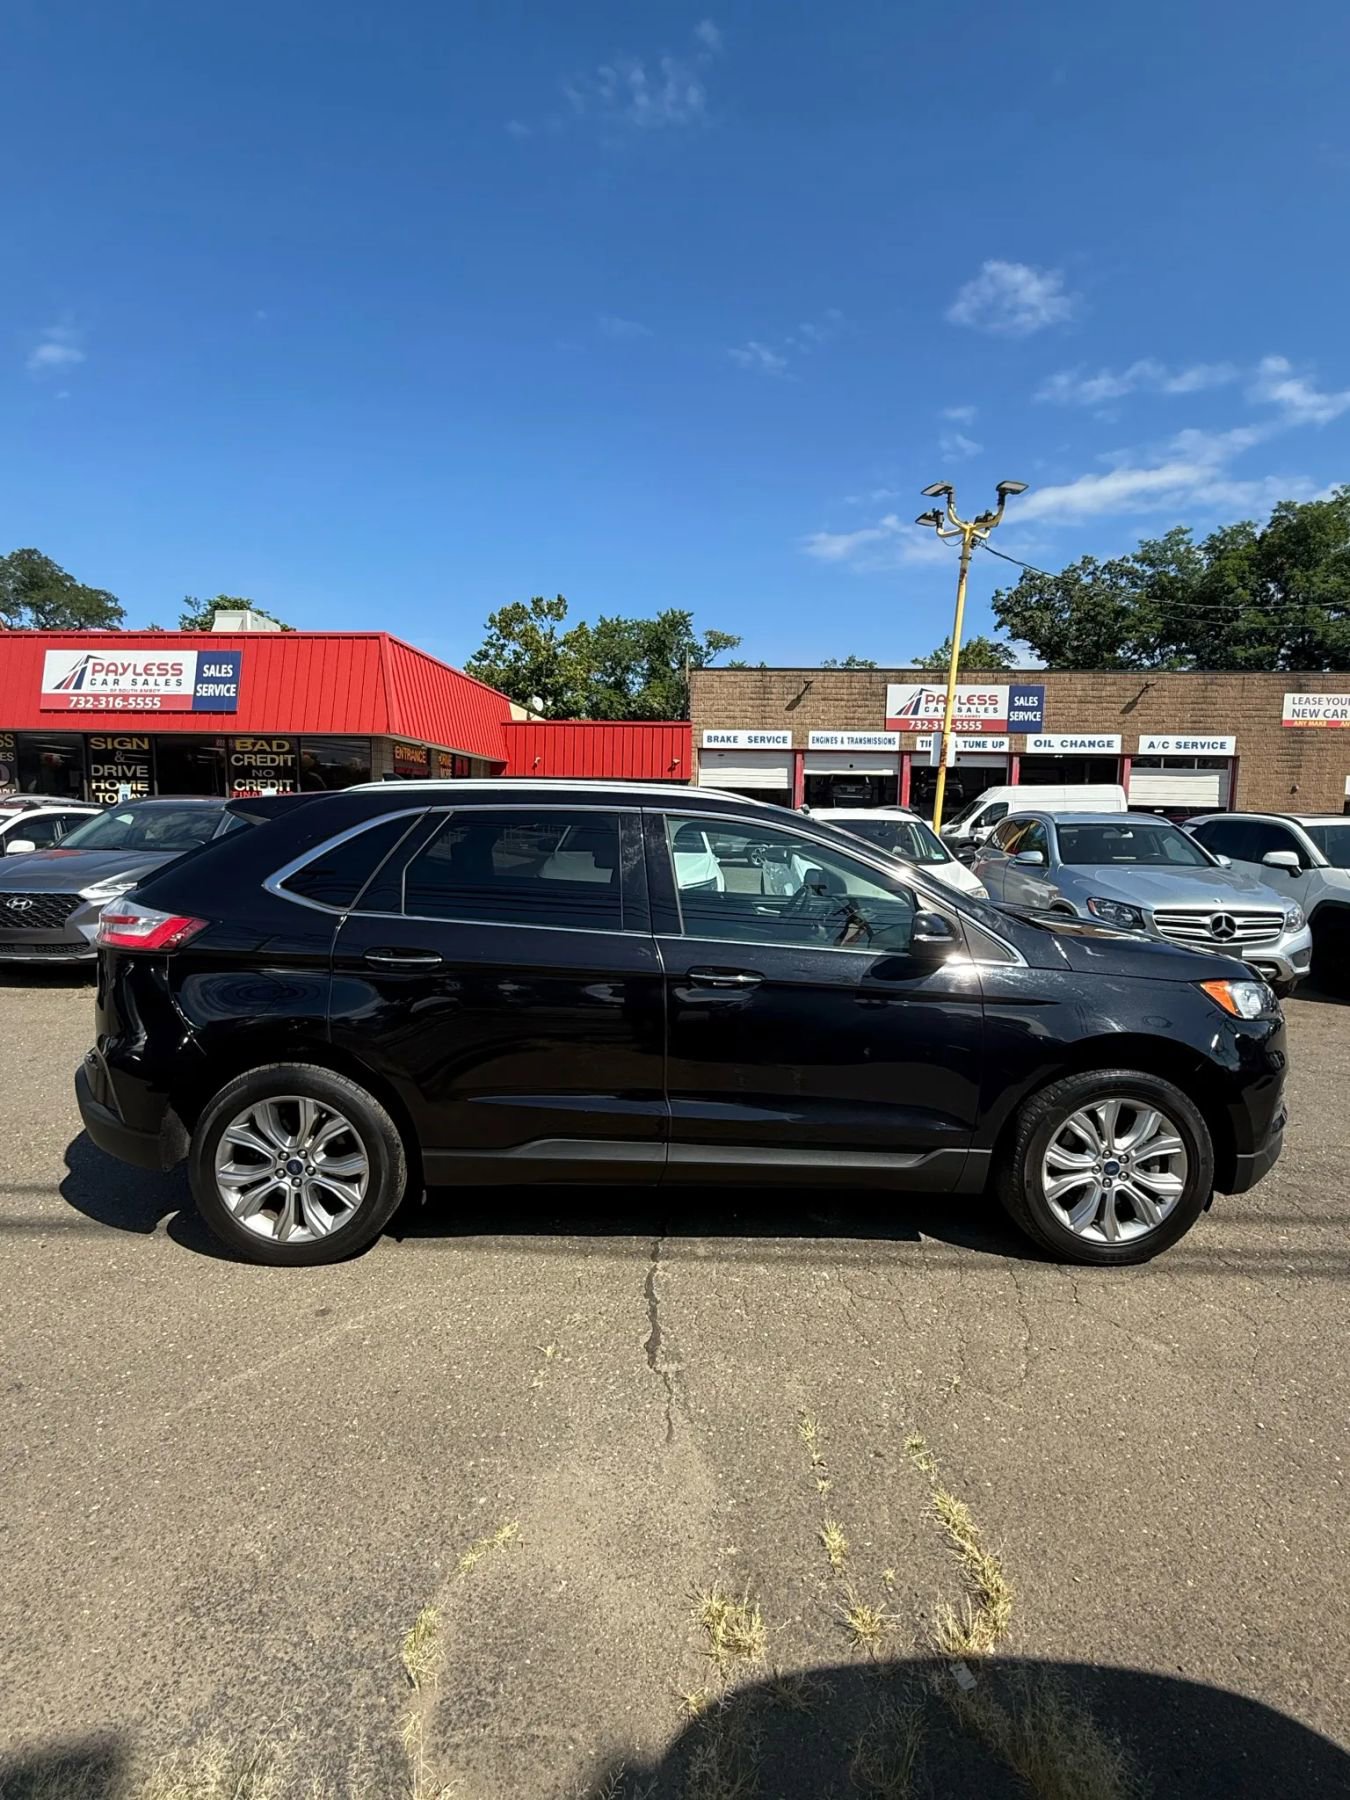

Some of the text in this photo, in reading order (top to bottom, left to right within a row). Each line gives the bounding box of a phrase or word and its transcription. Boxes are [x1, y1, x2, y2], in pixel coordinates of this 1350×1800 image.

[91, 662, 183, 676] PAYLESS
[202, 664, 233, 677] SALES
[90, 678, 183, 687] CAR SALES
[196, 683, 237, 696] SERVICE
[69, 696, 161, 709] 732-316-5555
[1014, 696, 1038, 706] SALES
[1292, 697, 1350, 706] LEASE YOU
[1009, 711, 1041, 721] SERVICE
[1291, 708, 1348, 718] NEW CAR
[909, 721, 982, 730] 732-31-5555
[90, 737, 150, 750] SIGN
[706, 735, 788, 744] BRAKE SERVICE
[811, 736, 839, 745] ENGINES
[847, 737, 897, 746] TRANSMISSIONS
[1033, 739, 1114, 748] OIL CHANGE
[235, 739, 290, 752] BAD
[963, 741, 988, 749] TUNE
[992, 741, 1005, 749] UP
[1147, 741, 1227, 750] A/C SERVICE
[114, 751, 125, 763] &
[230, 754, 296, 767] CREDIT
[91, 764, 149, 777] DRIVE
[252, 769, 275, 777] NO
[233, 779, 294, 791] CREDIT
